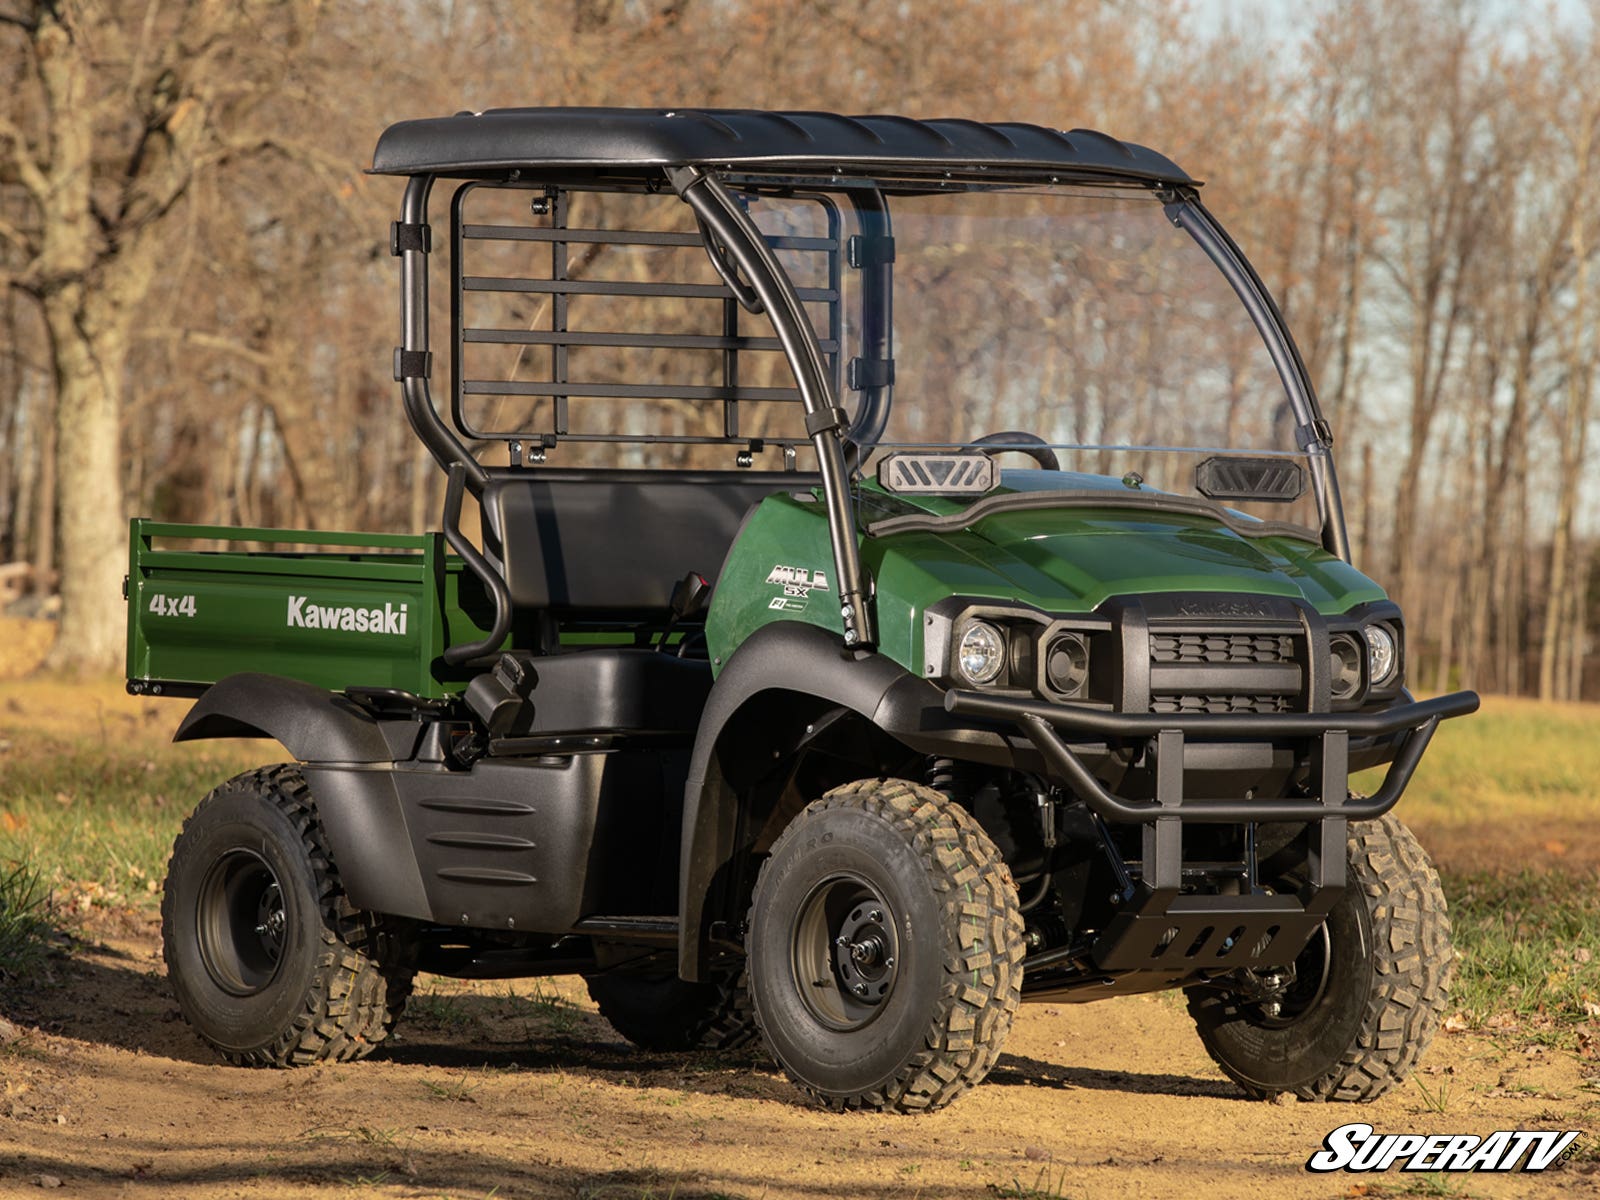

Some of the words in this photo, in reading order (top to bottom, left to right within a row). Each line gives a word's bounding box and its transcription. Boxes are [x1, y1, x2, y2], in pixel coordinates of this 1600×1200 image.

[784, 585, 808, 598] SX
[149, 594, 197, 617] 4x4
[287, 595, 408, 636] Kawasaki
